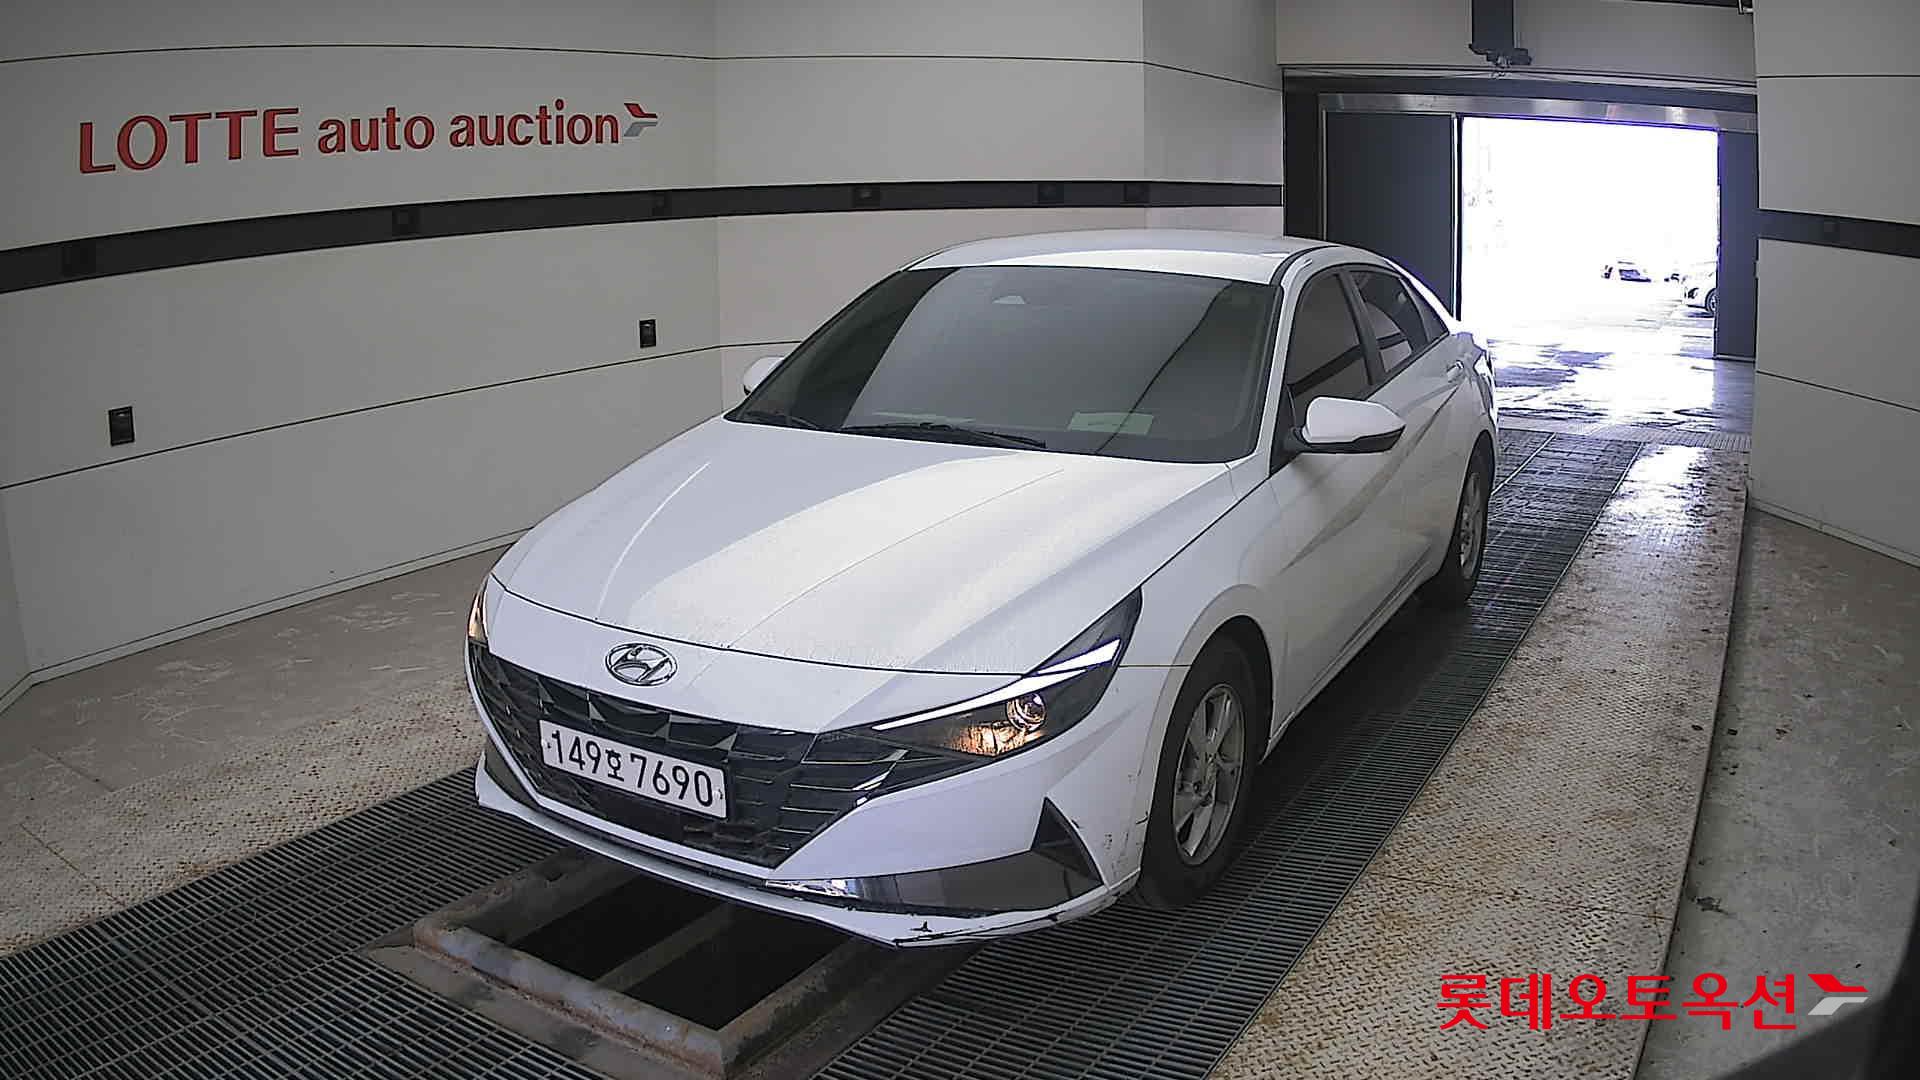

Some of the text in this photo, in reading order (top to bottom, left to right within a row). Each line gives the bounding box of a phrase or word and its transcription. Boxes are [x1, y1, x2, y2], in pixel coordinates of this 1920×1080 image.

[79, 99, 619, 174] LOTTE auto auction
